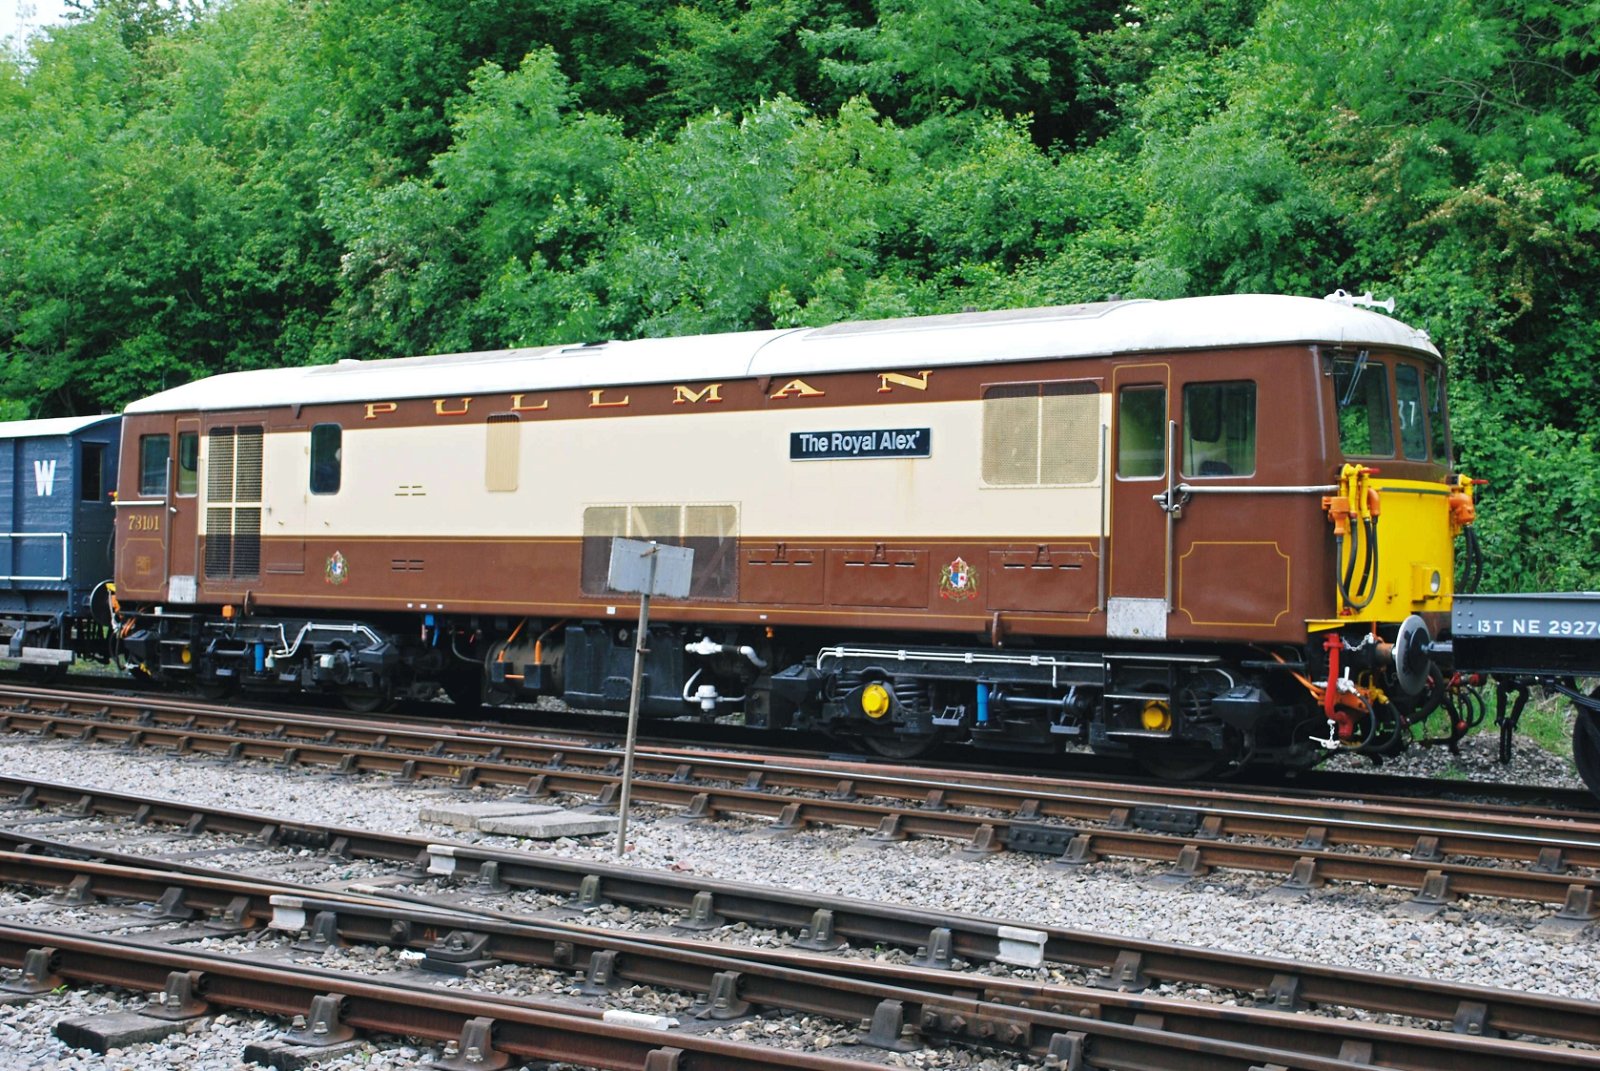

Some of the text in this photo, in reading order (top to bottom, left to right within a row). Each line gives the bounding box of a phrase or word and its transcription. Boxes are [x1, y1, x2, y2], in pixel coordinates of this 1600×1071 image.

[364, 370, 933, 420] PULLMAN
[800, 430, 920, 454] The Royal Alex'
[34, 459, 57, 497] W
[128, 515, 159, 531] 73101
[1512, 619, 1540, 634] NE
[1548, 620, 1600, 635] 2927
